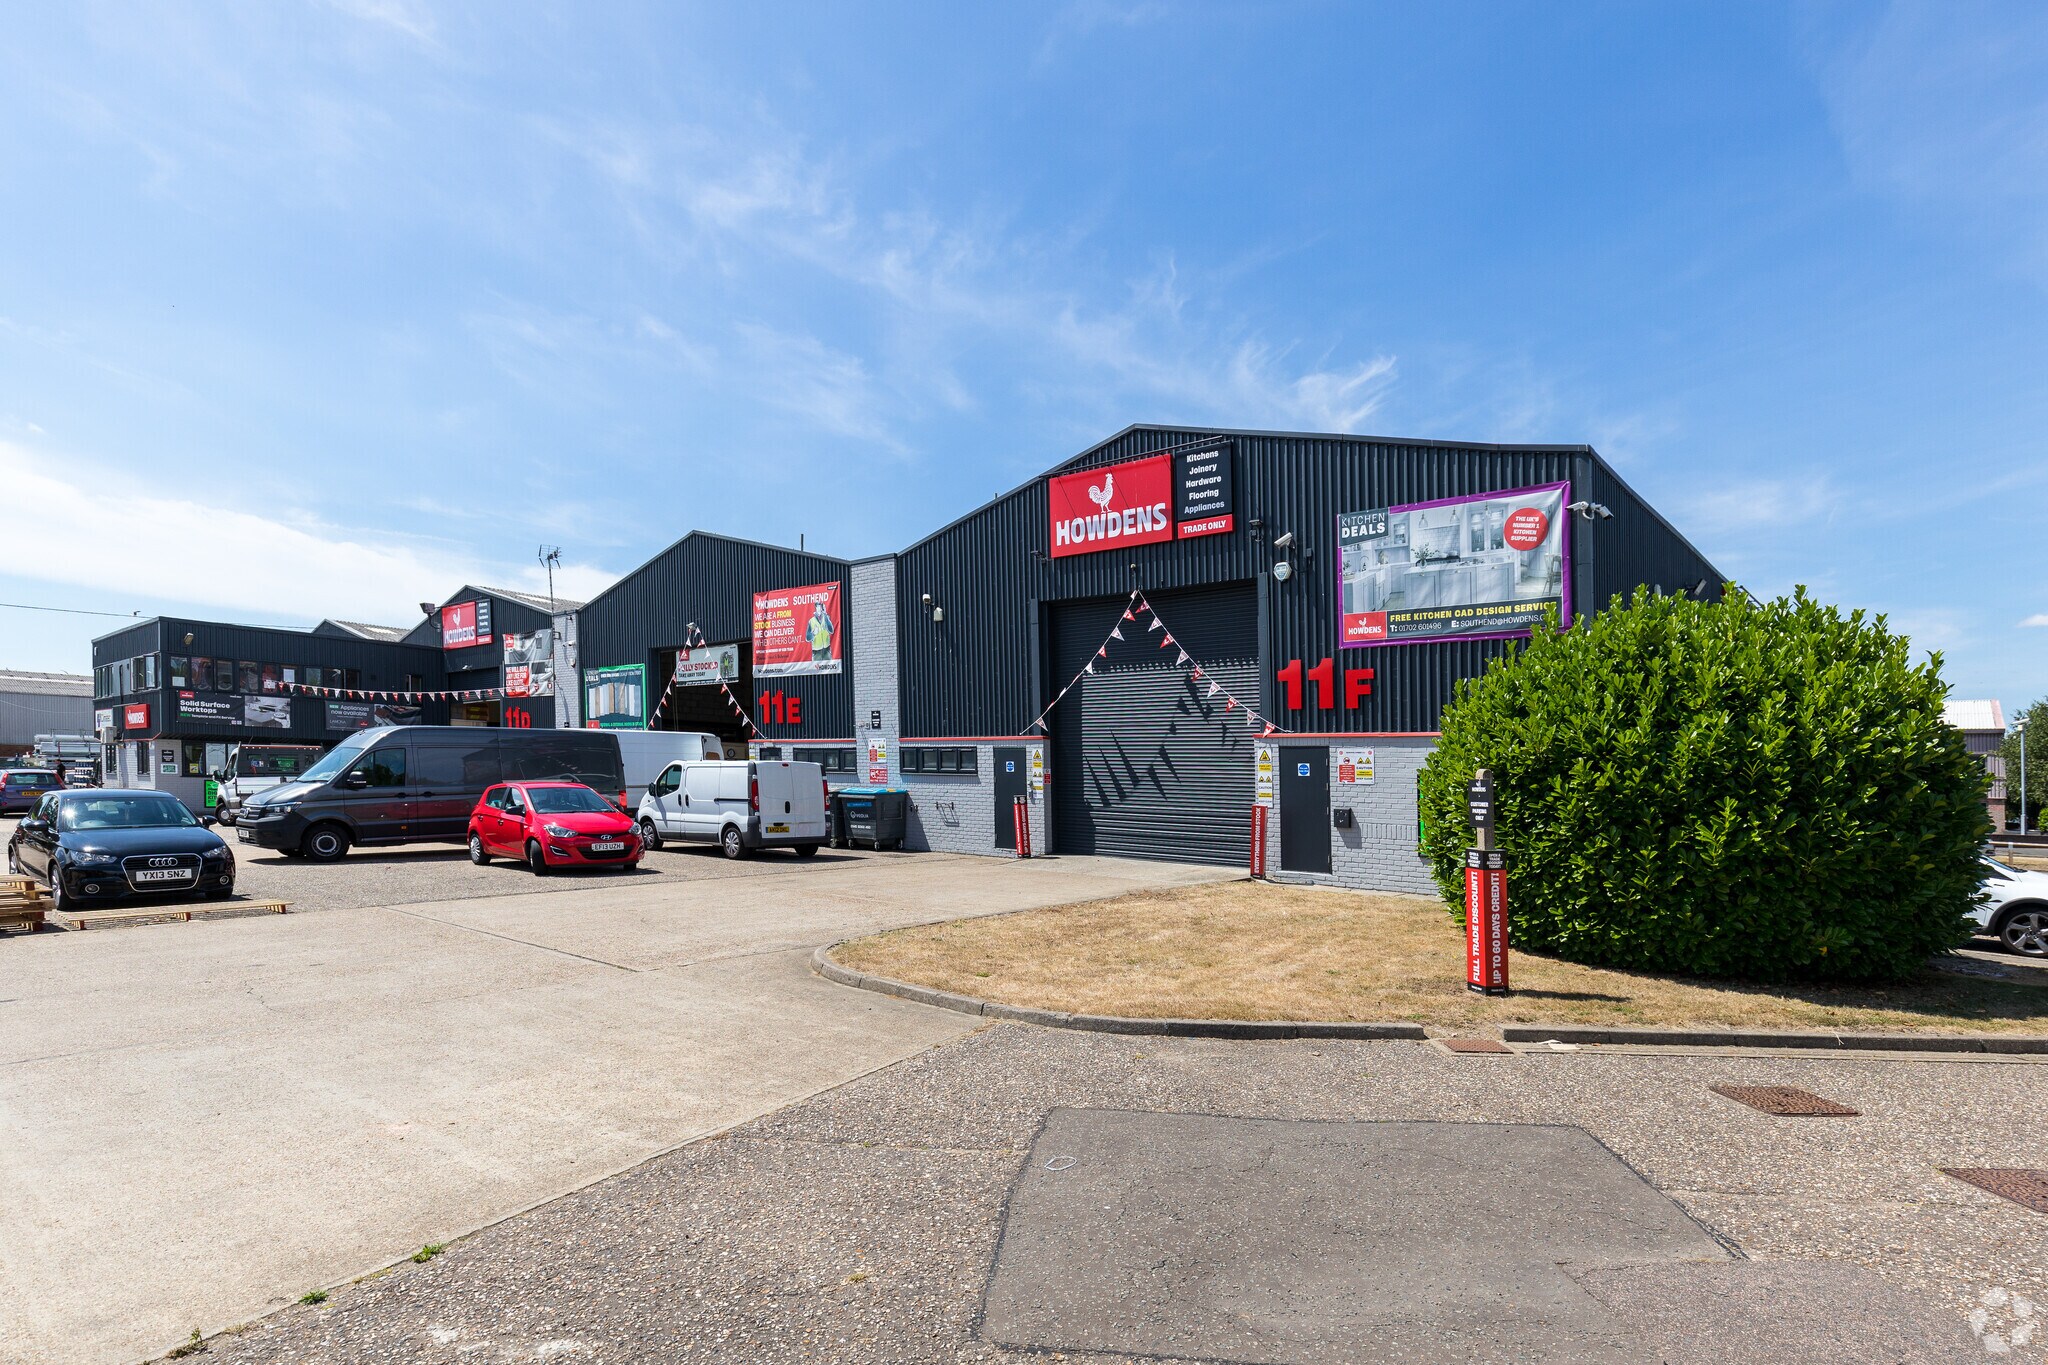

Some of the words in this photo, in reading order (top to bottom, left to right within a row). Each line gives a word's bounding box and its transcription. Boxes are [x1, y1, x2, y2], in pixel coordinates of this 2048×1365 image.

[1186, 449, 1219, 463] Kitchens
[1189, 464, 1217, 475] Joinery
[1185, 475, 1222, 488] Hardware
[1188, 489, 1219, 501] Flooring
[1184, 500, 1225, 514] Appliances
[1055, 502, 1167, 546] HOWDENS
[1183, 523, 1207, 534] TRADE
[1207, 519, 1227, 530] ONLY
[1341, 513, 1385, 527] KITCHEN
[1341, 522, 1386, 538] DEALS
[760, 597, 789, 609] HOWDENS
[793, 592, 829, 606] SOUTHEND
[754, 613, 763, 621] WE
[763, 611, 773, 620] ARE
[776, 609, 792, 618] FROM
[1390, 613, 1411, 622] FREE
[1413, 610, 1452, 621] KITCHEN
[1454, 609, 1474, 618] CAD
[1476, 605, 1512, 616] DESIGN
[754, 620, 771, 630] STOCK
[771, 618, 796, 628] BUSINESS
[1390, 624, 1398, 632] T:
[1398, 624, 1417, 632] 01702
[1417, 622, 1442, 630] 601496
[1451, 620, 1460, 628] E:
[1460, 613, 1545, 628] SOUTHEND@HOWDENS.C
[443, 625, 475, 646] HOWDENS
[754, 630, 763, 638] WE
[773, 627, 795, 636] DELIVER
[1348, 625, 1382, 635] HOWDENS
[694, 661, 718, 670] STOCKD
[1277, 657, 1374, 709] 11F
[180, 699, 200, 707] Solid
[200, 701, 231, 709] Surface
[180, 706, 217, 714] Worktops
[340, 704, 370, 712] Appliances
[758, 689, 801, 724] 11E
[143, 871, 164, 879] YX13
[167, 870, 186, 878] SNZ
[1471, 871, 1479, 924] DISCOUNT!
[1491, 872, 1500, 913] CREDIT!
[1491, 913, 1501, 939] DAYS
[1472, 925, 1480, 957] TRADE
[1492, 939, 1501, 955] 60
[1492, 955, 1501, 968] TO
[1493, 969, 1502, 984] UP
